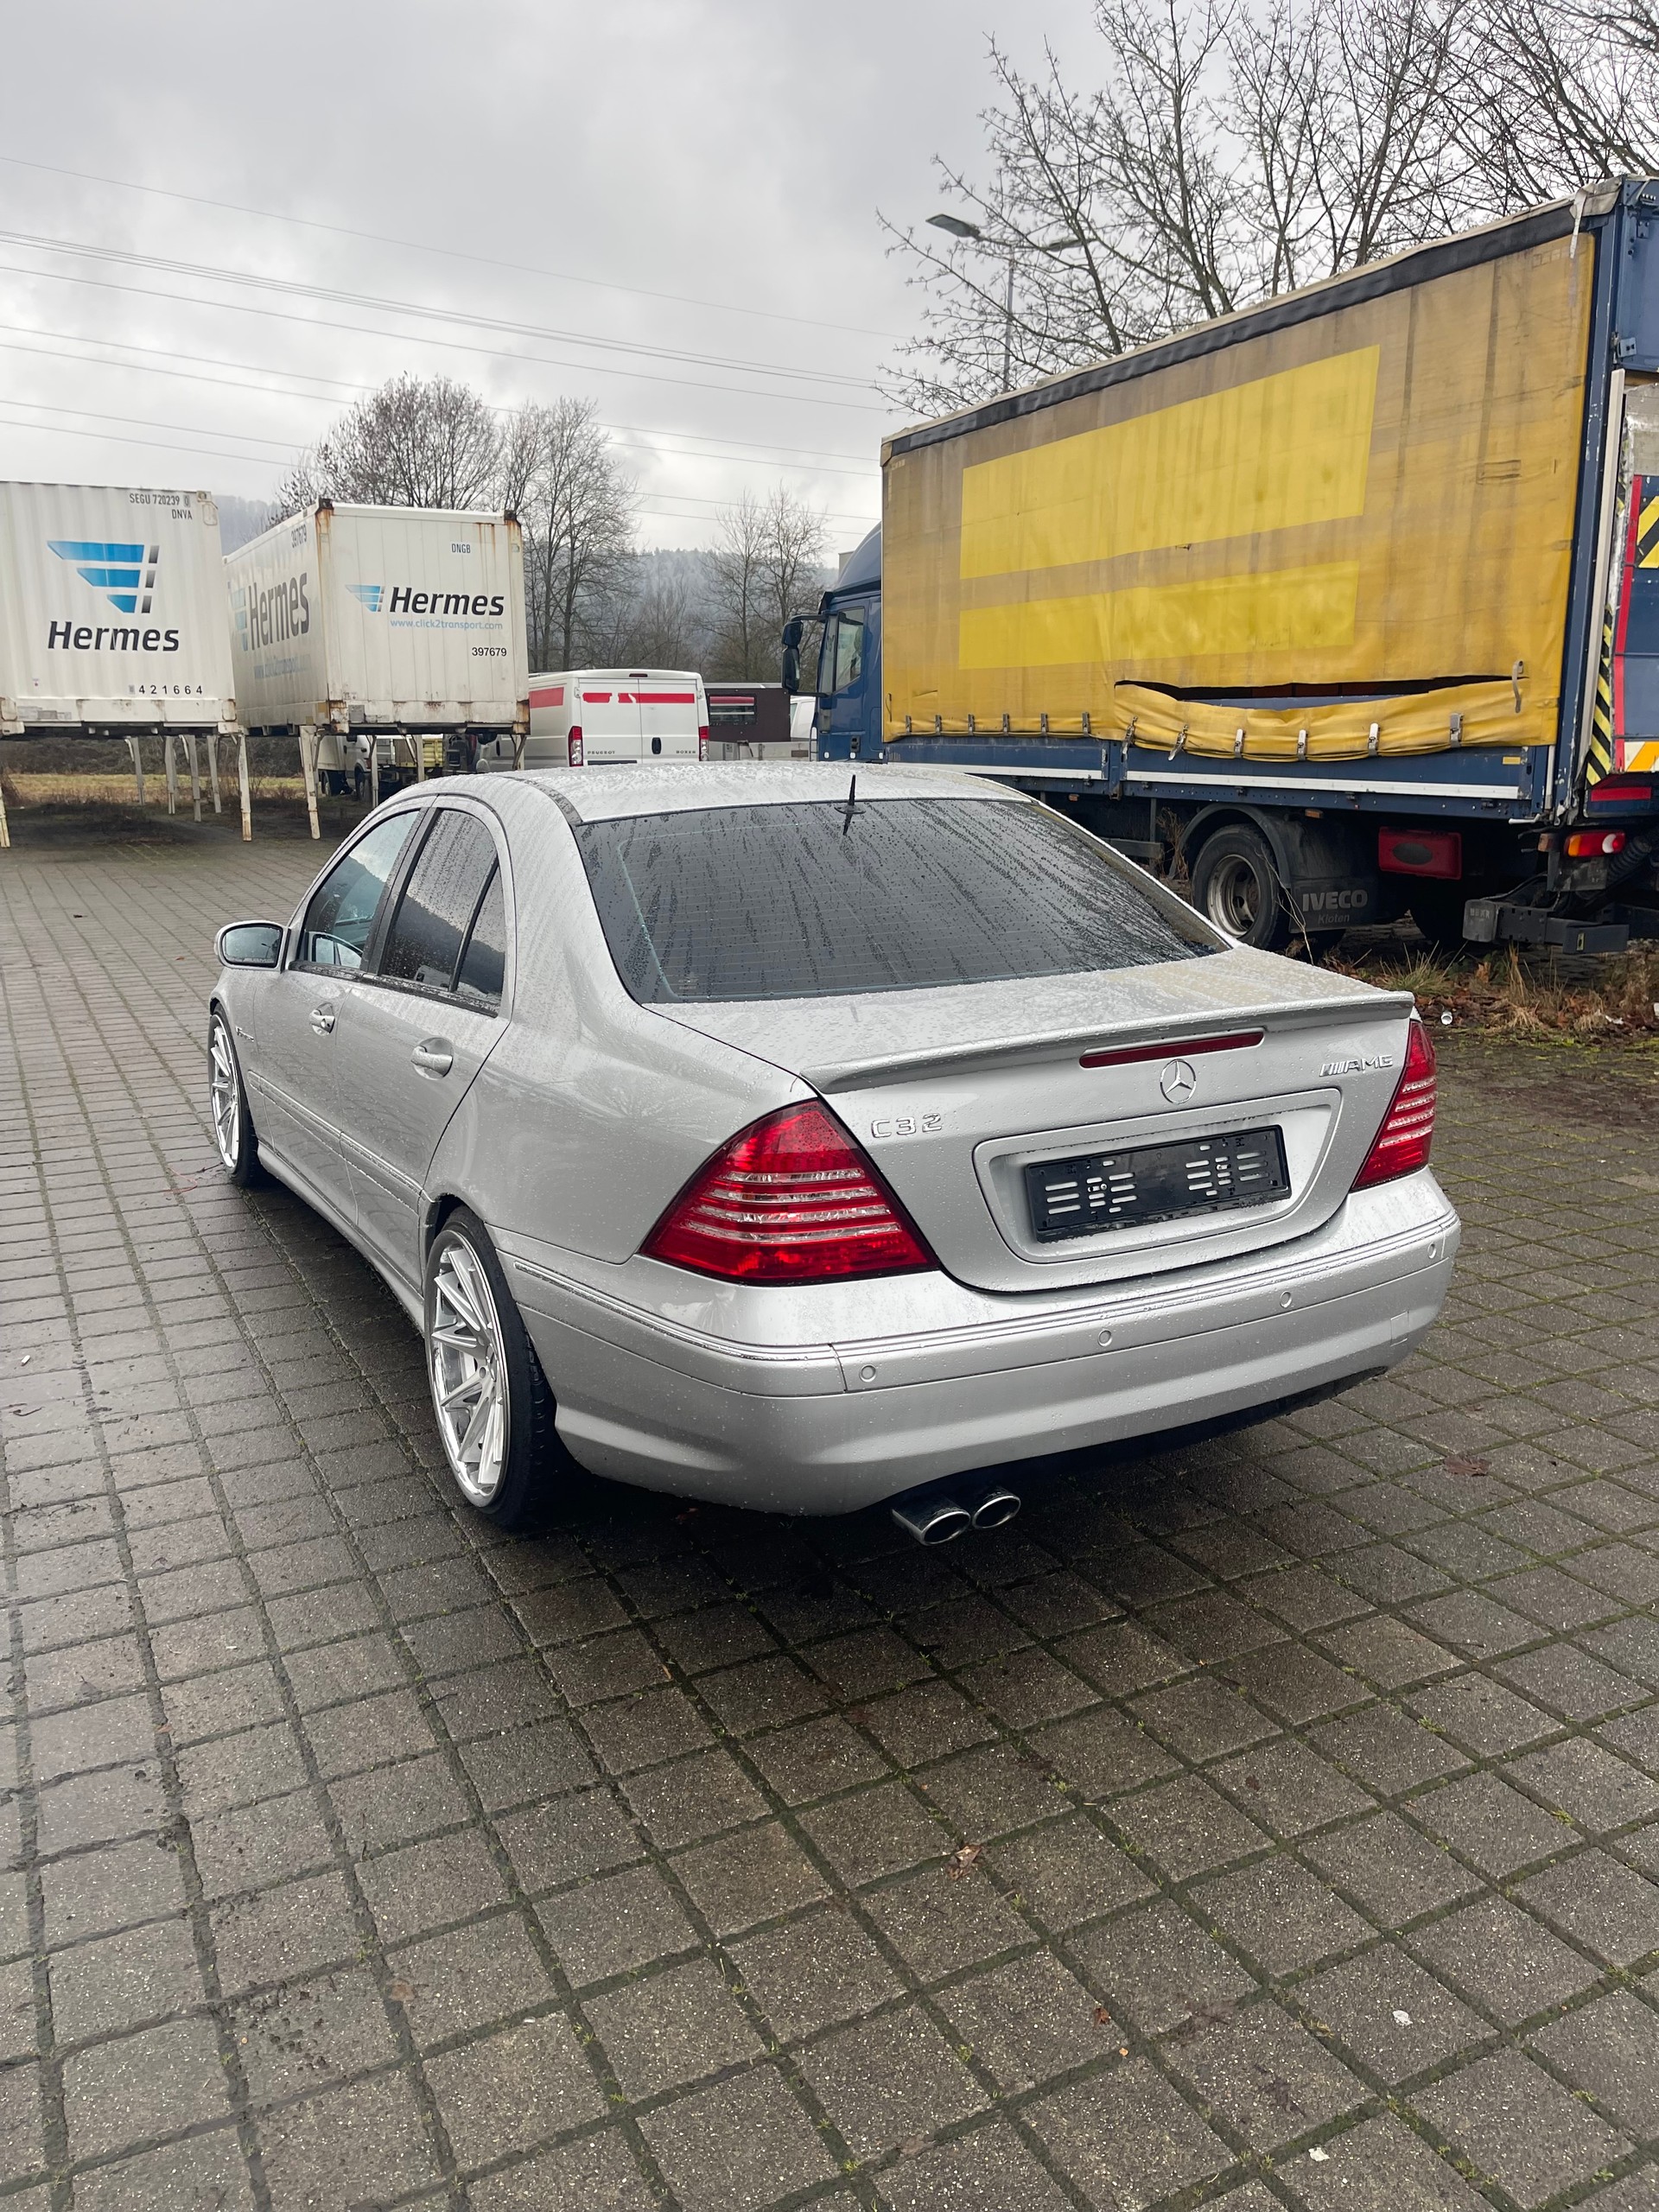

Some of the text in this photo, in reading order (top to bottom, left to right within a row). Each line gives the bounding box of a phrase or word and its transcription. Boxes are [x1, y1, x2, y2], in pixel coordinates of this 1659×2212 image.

[130, 493, 150, 504] SEGU
[152, 494, 180, 505] 720239
[249, 572, 309, 651] Hermes
[389, 586, 505, 616] Hermes
[48, 620, 180, 652] Hermes
[390, 619, 503, 631] www.click2transport.com
[472, 647, 507, 657] 397679
[1302, 889, 1369, 912] IVECO
[1318, 913, 1351, 925] Kloten
[871, 1113, 943, 1139] C32
